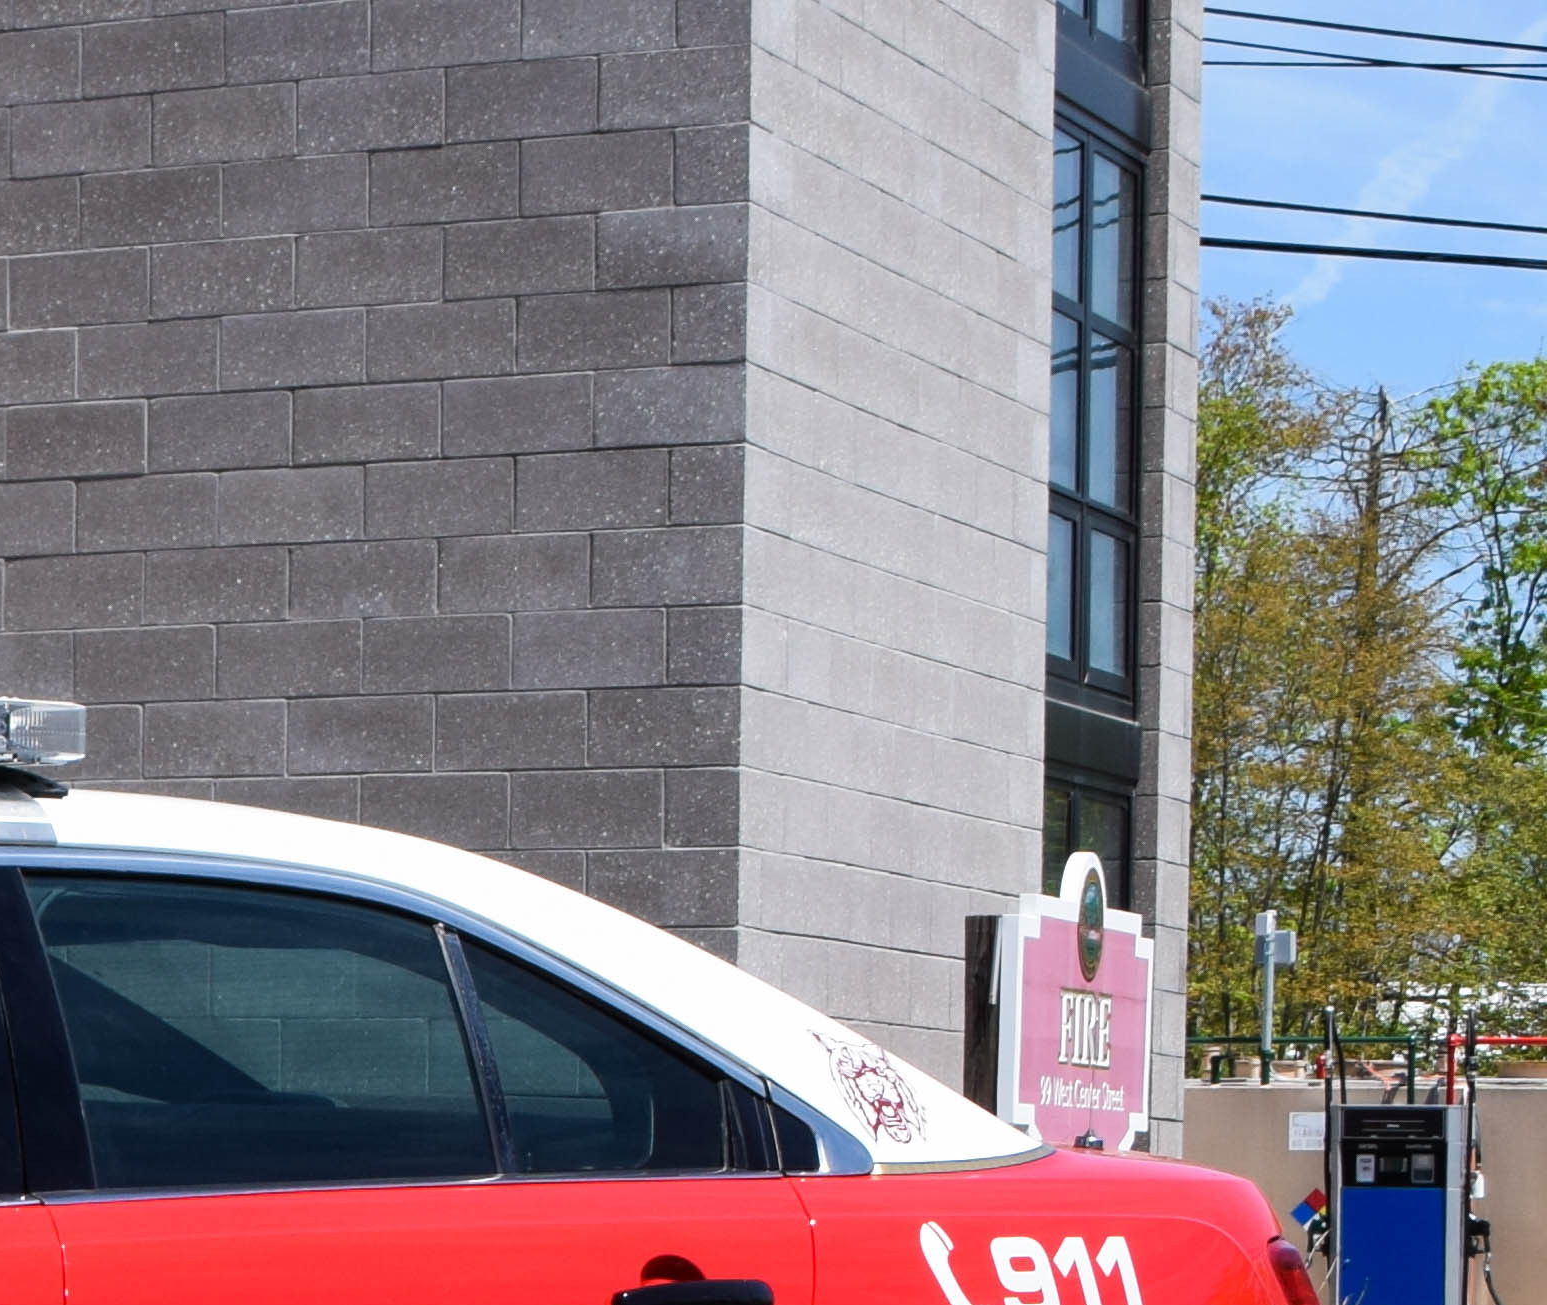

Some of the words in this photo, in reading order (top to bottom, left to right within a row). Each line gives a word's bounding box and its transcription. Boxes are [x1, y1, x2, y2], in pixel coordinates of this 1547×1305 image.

[1058, 988, 1113, 1070] FIRE
[1040, 1075, 1052, 1105] 99
[1053, 1077, 1073, 1108] West
[1074, 1079, 1101, 1109] Center
[1102, 1081, 1125, 1111] Street
